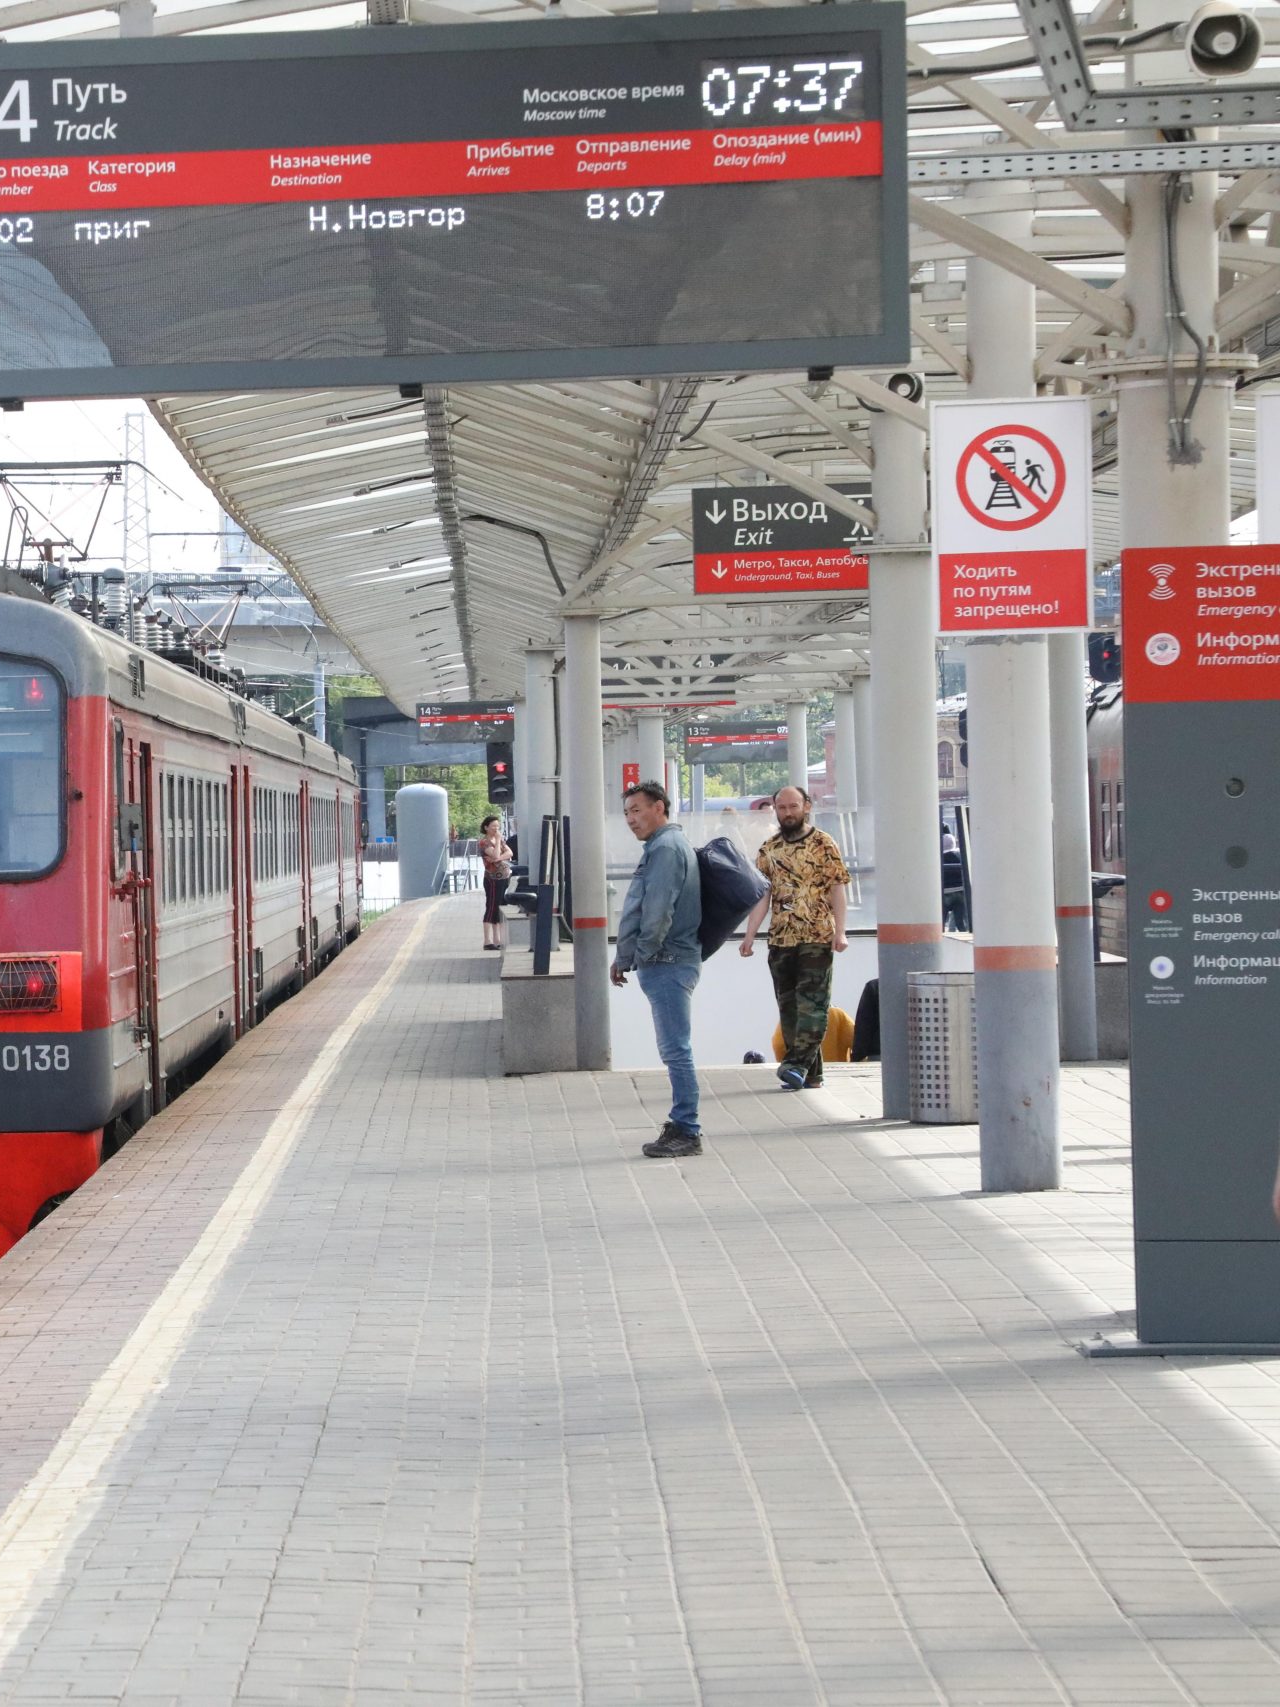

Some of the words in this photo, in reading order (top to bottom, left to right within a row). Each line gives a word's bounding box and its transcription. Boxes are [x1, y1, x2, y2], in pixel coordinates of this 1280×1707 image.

[51, 77, 127, 114] Путь
[523, 86, 628, 105] Московское
[631, 83, 685, 102] время
[701, 61, 863, 117] 07:37
[523, 107, 577, 121] Moscow
[578, 106, 607, 120] time
[54, 119, 118, 142] Track
[713, 130, 810, 148] Опоздание
[813, 127, 862, 145] (мин)
[466, 142, 555, 161] Прибытие
[576, 136, 692, 156] Отправление
[88, 159, 176, 176] Категория
[270, 151, 372, 170] Назначение
[577, 159, 628, 174] Departs
[714, 154, 751, 167] Delay
[753, 151, 787, 165] (min)
[11, 162, 69, 180] поезда
[467, 163, 511, 177] Arrives
[89, 180, 118, 193] Class
[271, 172, 343, 187] Destination
[586, 191, 666, 221] 8:07
[74, 222, 151, 244] приг
[732, 498, 828, 523] Выход
[734, 527, 774, 546] Exit
[734, 559, 776, 569] Метро,
[777, 558, 813, 567] Такси,
[953, 563, 1018, 580] Ходить
[734, 572, 793, 583] Underground,
[796, 572, 815, 580] Taxi,
[817, 571, 840, 579] Buses
[952, 583, 977, 599] по
[981, 582, 1032, 600] путям
[1196, 586, 1256, 598] вызов
[953, 599, 1060, 618] запрещено!
[1198, 604, 1276, 618] Emergency
[420, 707, 431, 715] 14
[688, 727, 699, 735] 13
[1192, 913, 1242, 924] вызов
[1194, 931, 1259, 942] Emergency
[1194, 974, 1267, 985] Information
[2, 1044, 71, 1073] 0138
